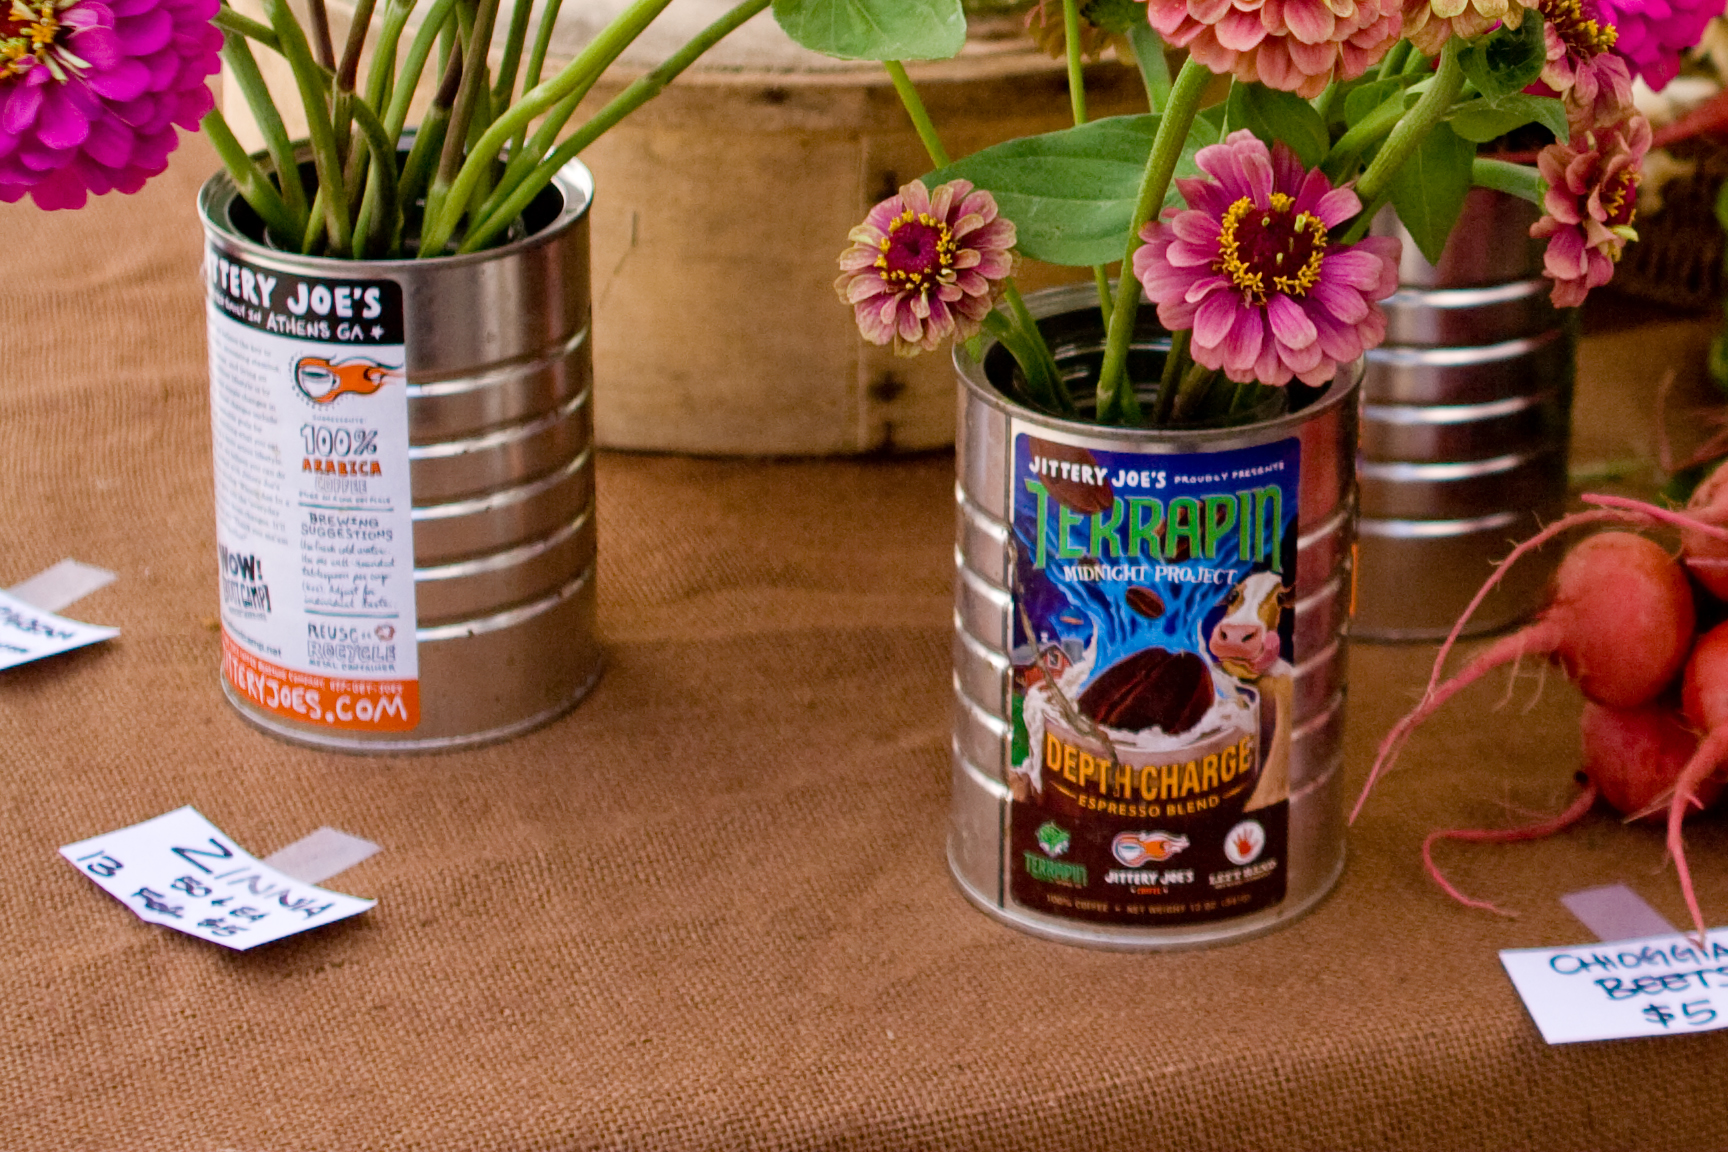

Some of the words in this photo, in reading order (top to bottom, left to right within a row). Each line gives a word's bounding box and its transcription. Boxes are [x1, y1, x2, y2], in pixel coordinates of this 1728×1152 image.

[286, 282, 382, 320] JOE'S
[266, 311, 331, 339] ATHENS
[336, 321, 364, 341] GA
[300, 423, 378, 457] 100%
[302, 458, 382, 477] ARABICA
[1029, 456, 1107, 486] JITTERY
[1112, 470, 1166, 489] JOE'S
[301, 522, 393, 542] SUGGESTIONS
[309, 512, 379, 528] BREWING
[1025, 478, 1284, 574] TERRAPIN
[1063, 565, 1148, 582] MIDNIGHT
[1154, 567, 1238, 585] PROJECT
[307, 640, 396, 663] RECYCLE
[1046, 731, 1131, 799] DEPTH
[1141, 736, 1252, 800] CHARGE
[1078, 794, 1160, 817] ESPRESSO
[1167, 794, 1220, 816] BLEND
[1104, 868, 1159, 885] JITTERY
[1159, 868, 1195, 885] JOE'S
[1641, 999, 1718, 1029] $5
